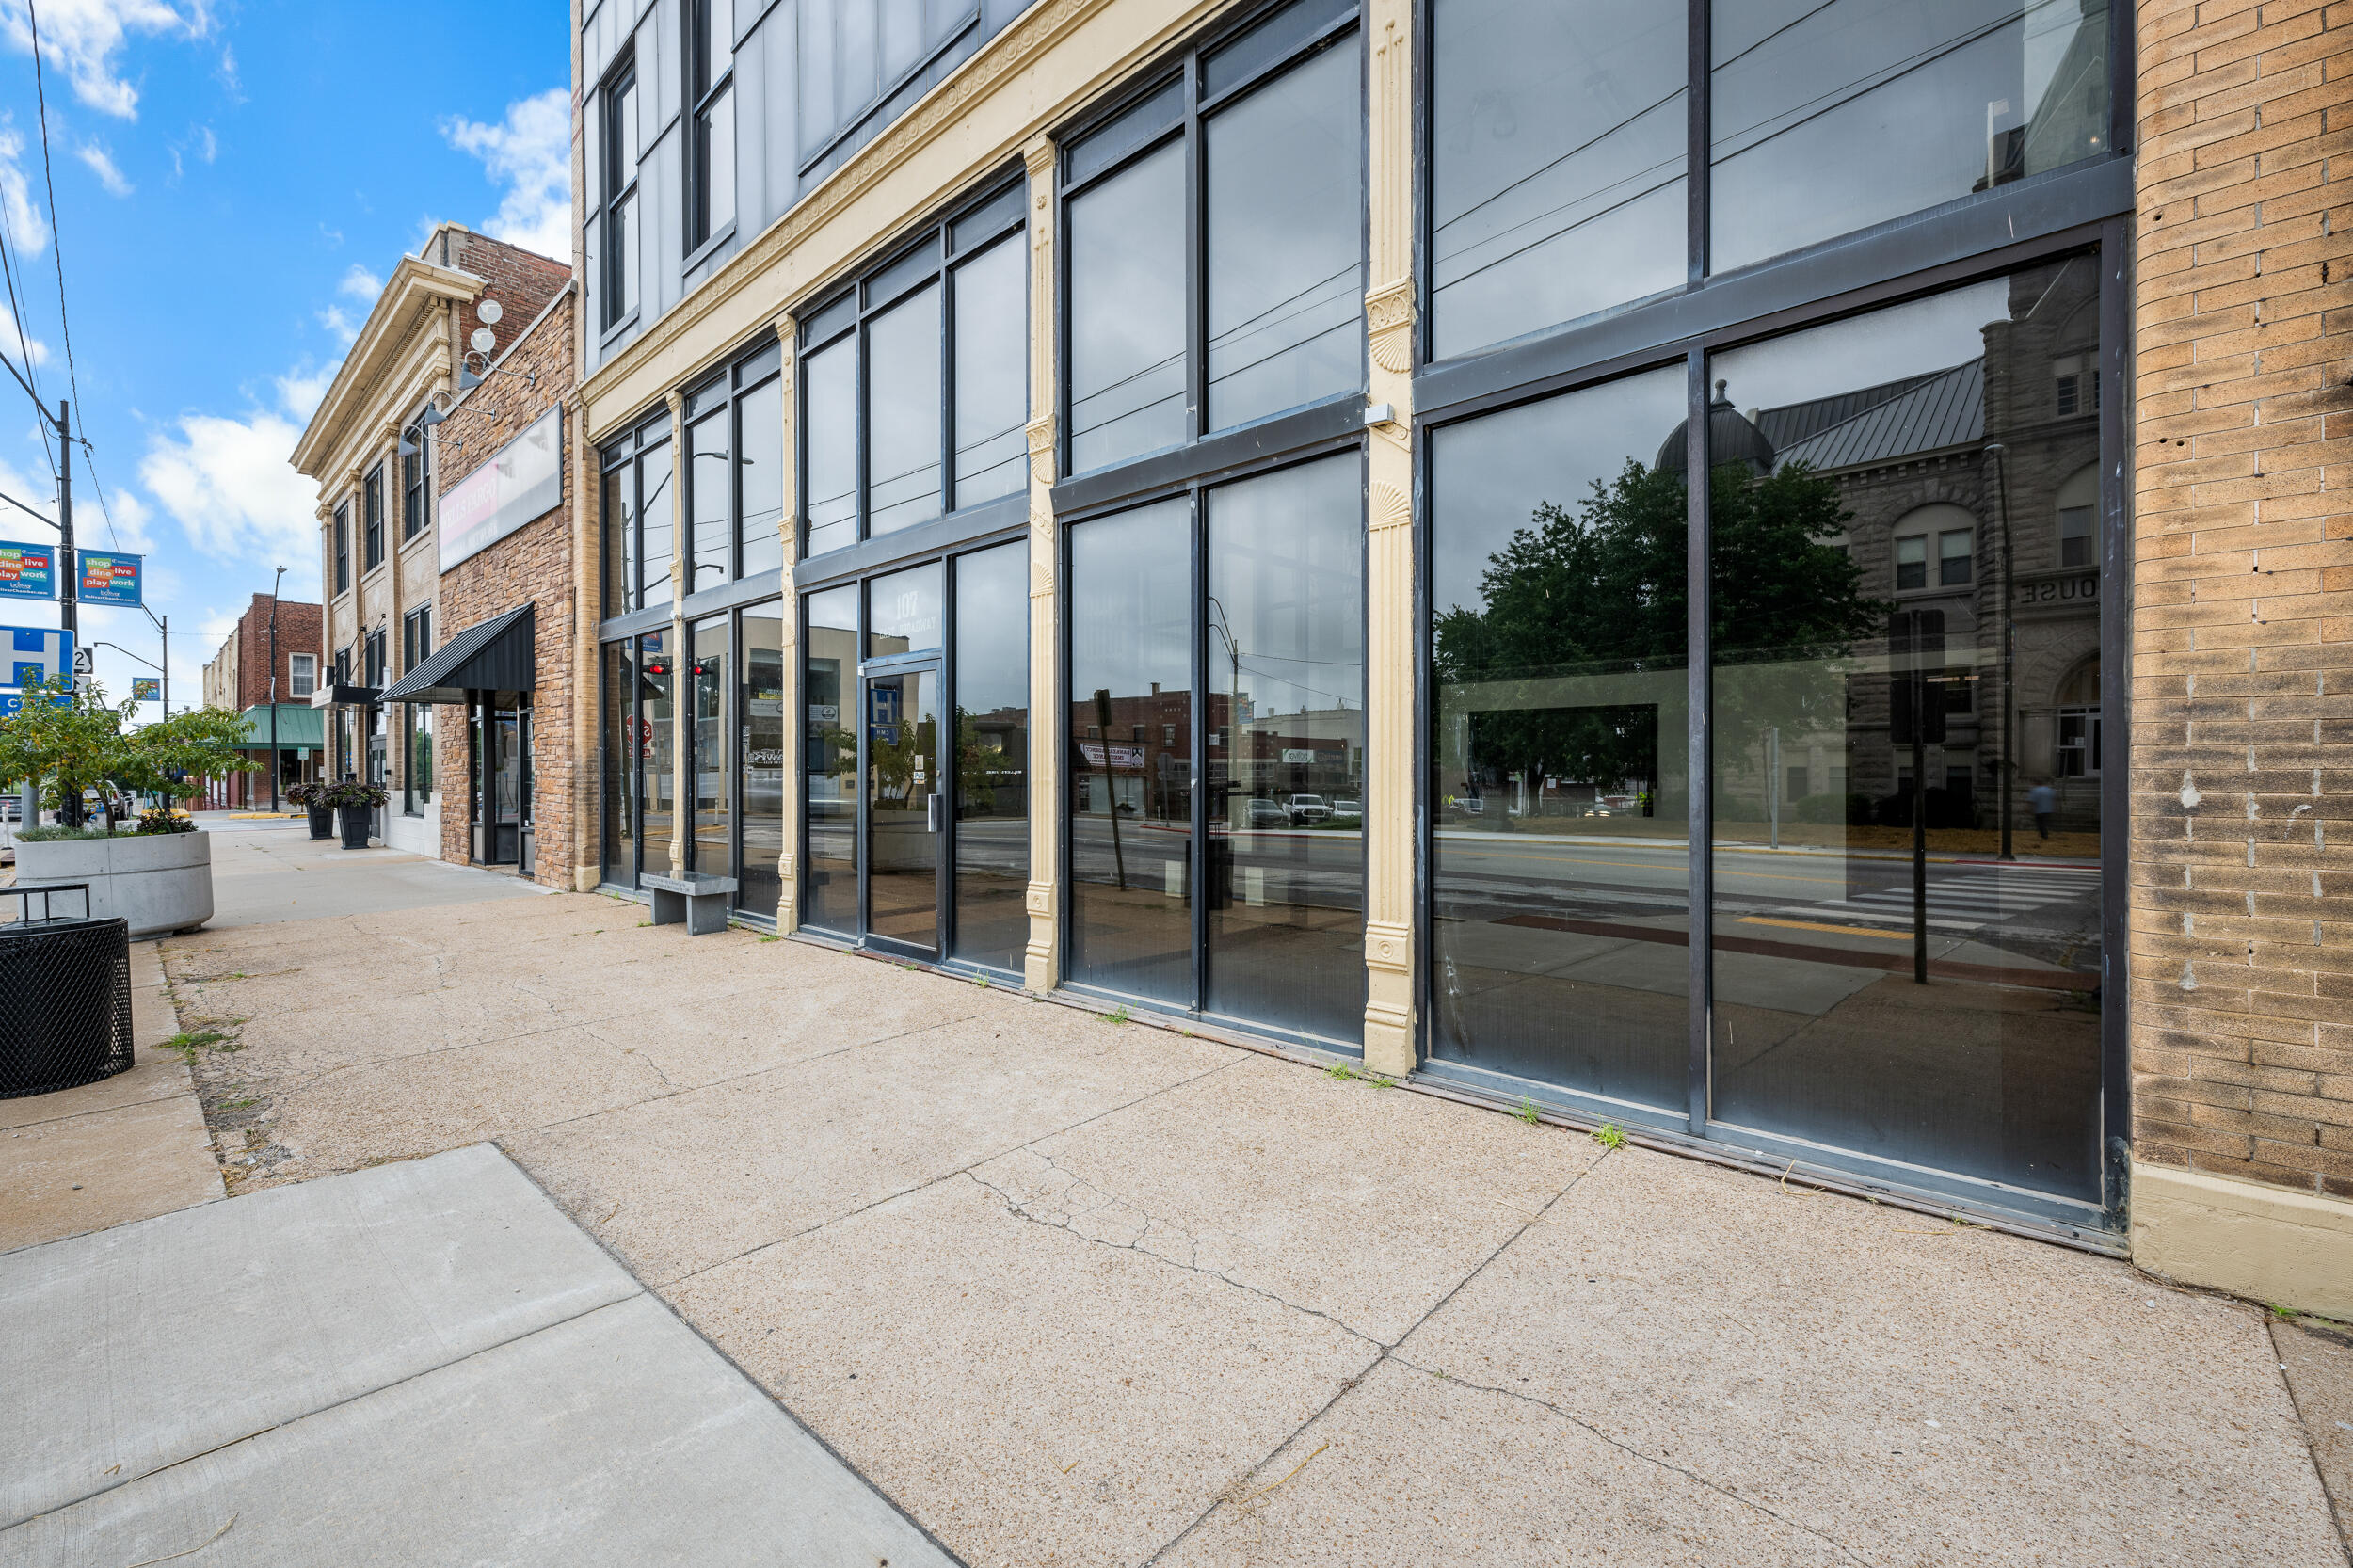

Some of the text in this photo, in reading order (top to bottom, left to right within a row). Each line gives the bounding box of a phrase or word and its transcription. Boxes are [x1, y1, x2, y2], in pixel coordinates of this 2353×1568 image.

[0, 549, 20, 559] hop
[24, 558, 44, 567] live
[86, 558, 111, 567] shop
[89, 568, 112, 577] dine
[86, 578, 107, 587] play
[897, 590, 919, 621] 107
[0, 630, 60, 685] H
[74, 651, 85, 666] 2
